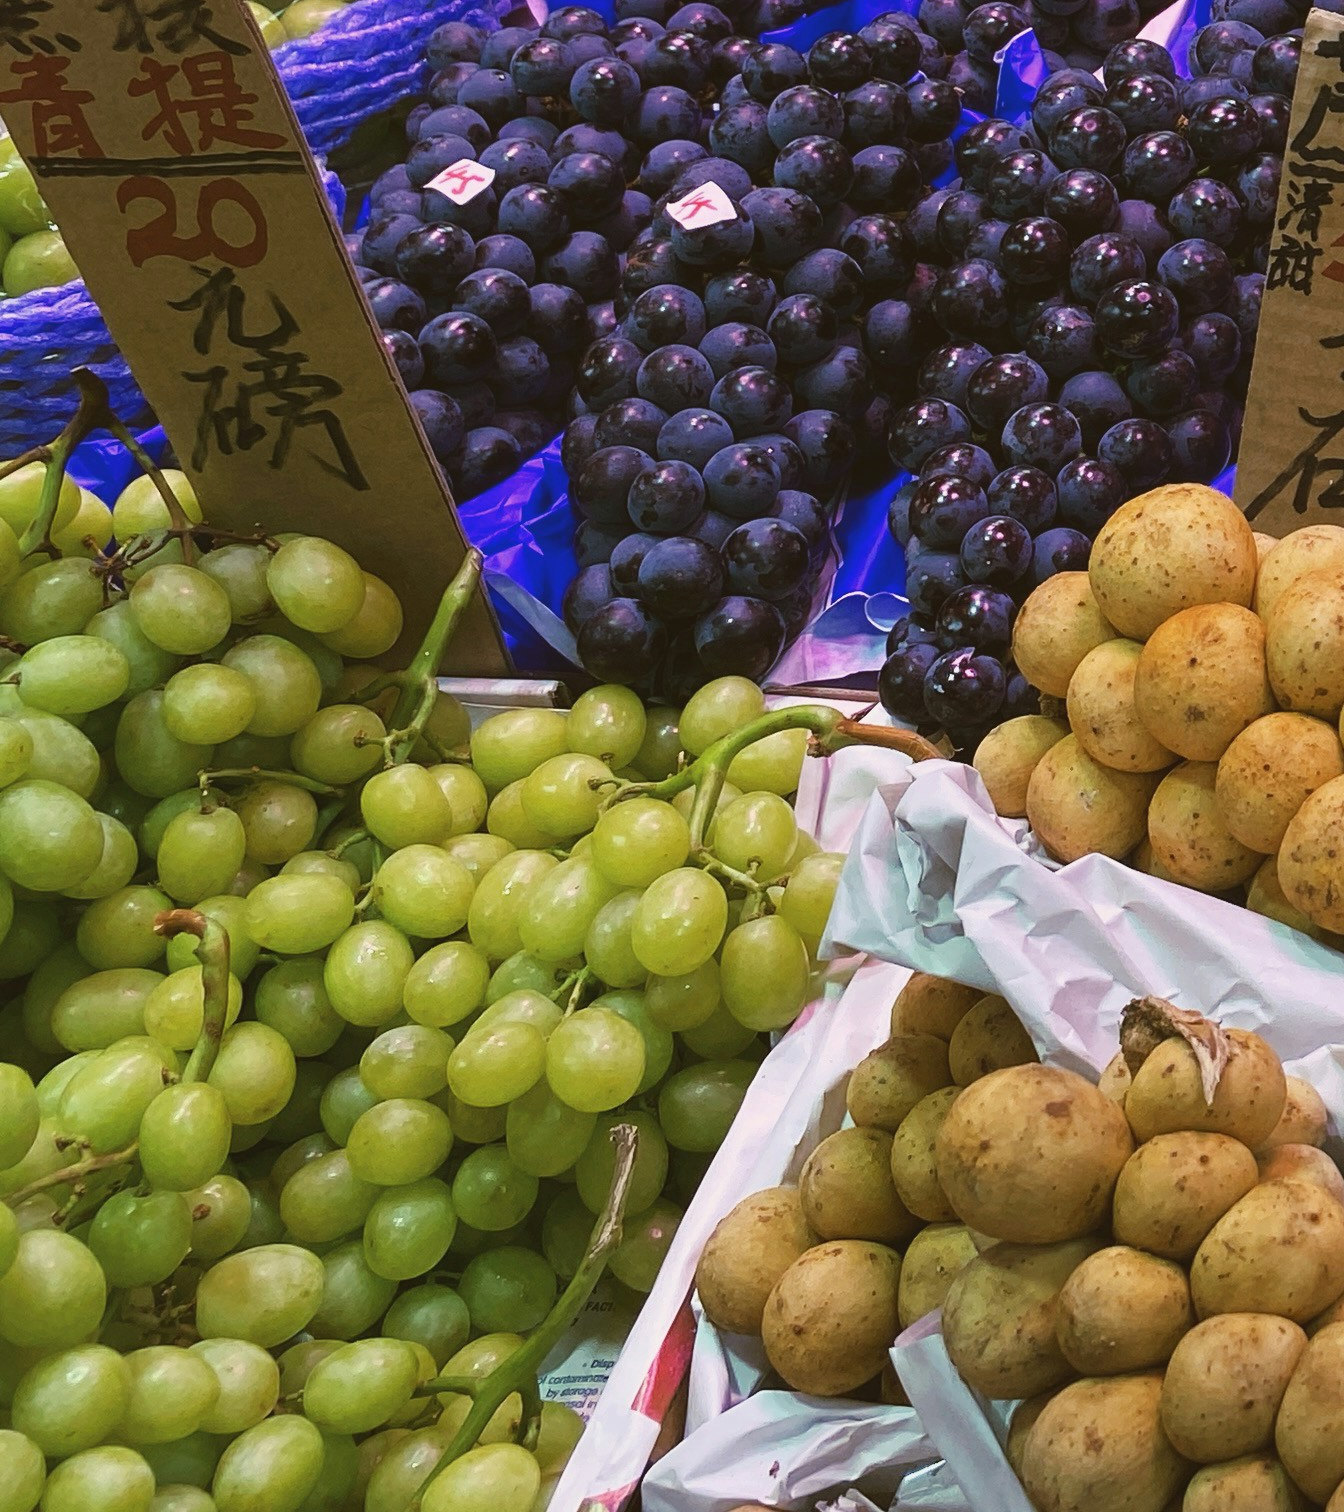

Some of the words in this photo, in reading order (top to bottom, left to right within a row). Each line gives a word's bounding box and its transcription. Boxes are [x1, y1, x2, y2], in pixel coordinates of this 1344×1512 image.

[2, 52, 288, 160] 青提
[116, 176, 269, 270] 20
[166, 264, 303, 356] 元
[179, 346, 373, 492] 磅
